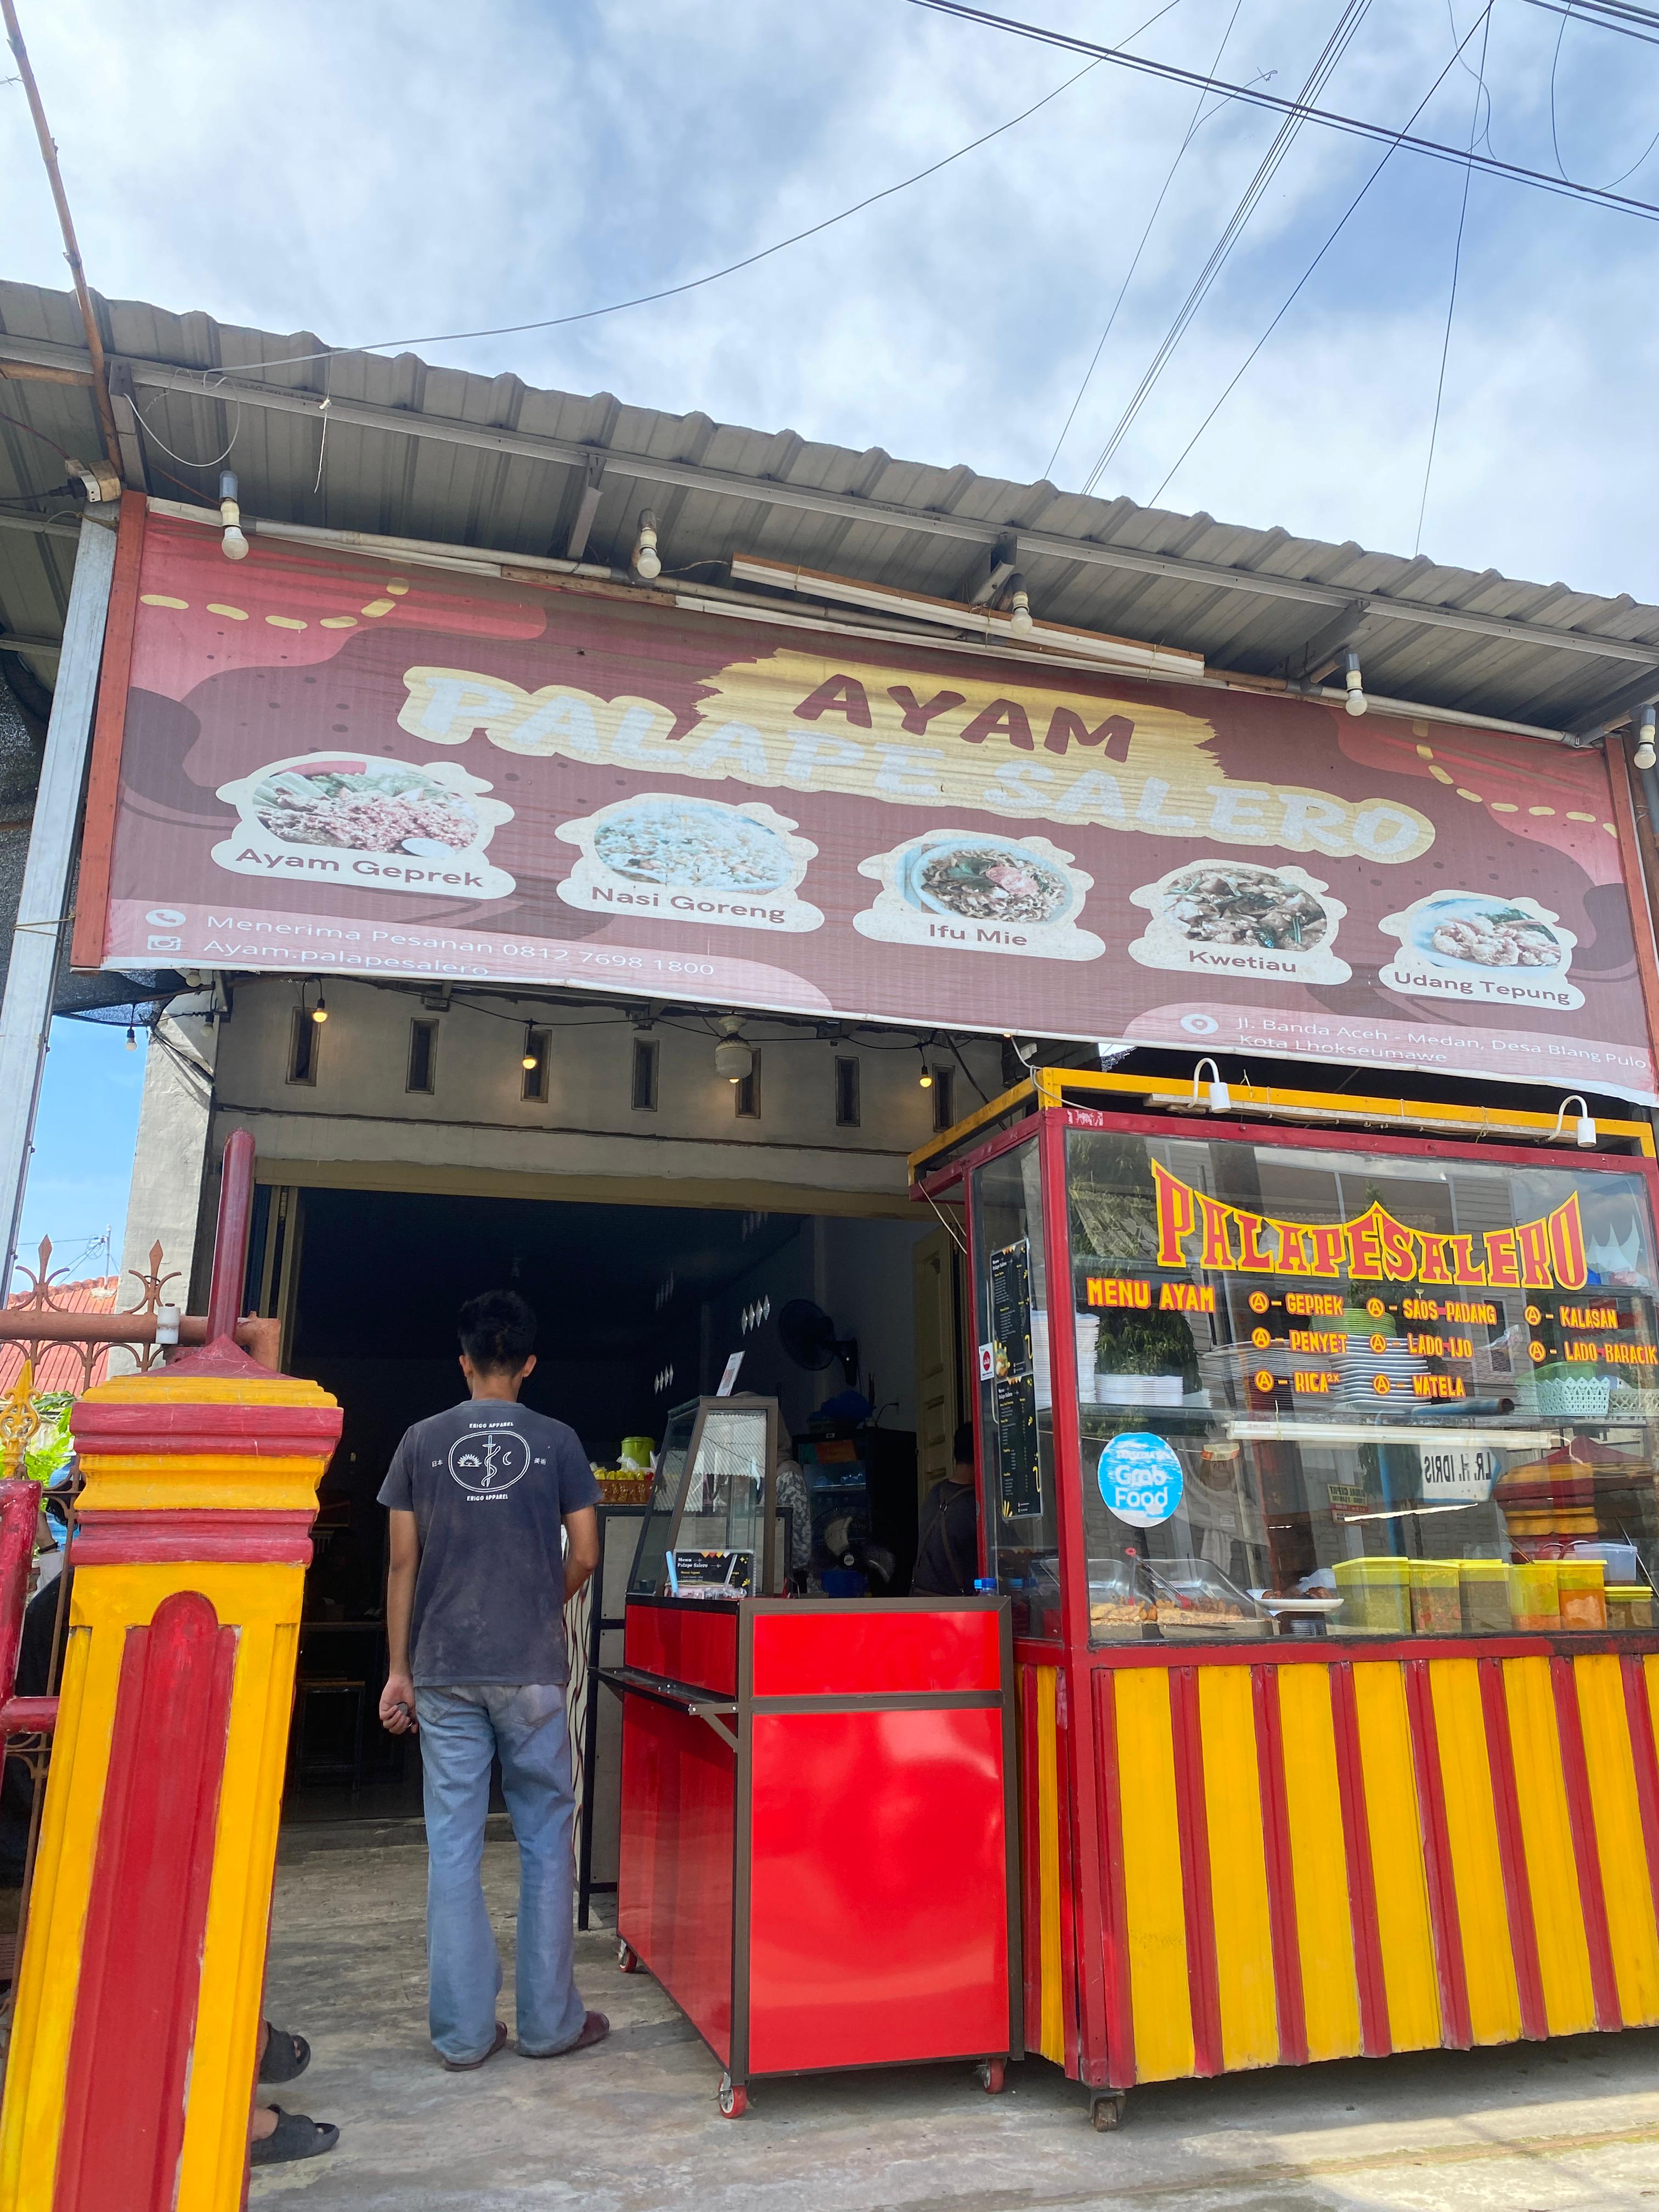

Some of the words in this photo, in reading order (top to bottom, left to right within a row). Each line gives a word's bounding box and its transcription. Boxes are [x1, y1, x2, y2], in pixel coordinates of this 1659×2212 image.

[793, 674, 1135, 763] AYAM
[420, 676, 945, 798] PALAPE
[983, 759, 1420, 855] SALERO
[235, 848, 340, 872] Ayam
[353, 860, 483, 888] Geprek
[592, 887, 658, 907] Nasi
[670, 895, 785, 924] Goreng
[207, 915, 360, 941] Menerima
[373, 930, 492, 953] Pesanan
[503, 944, 569, 962] 0812
[579, 951, 643, 968] 7698
[653, 959, 714, 975] 1800
[930, 924, 965, 940] Ifu
[977, 928, 1027, 946] Mie
[203, 940, 489, 976] Ayam.palapesalero
[1189, 950, 1296, 973] Kwetiau
[1394, 972, 1473, 994] Udang
[1480, 981, 1570, 1005] Tepung
[1236, 1017, 1254, 1029] Jl.
[1263, 1019, 1329, 1036] Banda
[1337, 1026, 1387, 1041] Aceh
[1408, 1032, 1485, 1051] Medan,
[1492, 1040, 1542, 1053] Desa
[1548, 1045, 1601, 1063] Blang
[1605, 1054, 1646, 1069] Pulo
[1238, 1034, 1288, 1049] Kota
[1295, 1040, 1447, 1062] Lhokseumawe
[1086, 1277, 1151, 1310] MENU
[1159, 1282, 1216, 1313] AYAM
[1285, 1292, 1344, 1316] GEPREK
[1402, 1298, 1438, 1320] SAOS
[1444, 1301, 1497, 1325] PADANG
[1559, 1305, 1618, 1329] KALASAN
[1289, 1329, 1348, 1353] PENYET
[1407, 1332, 1444, 1357] LADO
[1449, 1336, 1475, 1358] IJO
[1564, 1340, 1598, 1363] LADO
[1603, 1342, 1659, 1365] BARACIK
[1412, 1375, 1466, 1398] WATELA
[431, 1459, 443, 1468] 日本
[1115, 1464, 1167, 1486] Grab
[1115, 1486, 1168, 1508] Food
